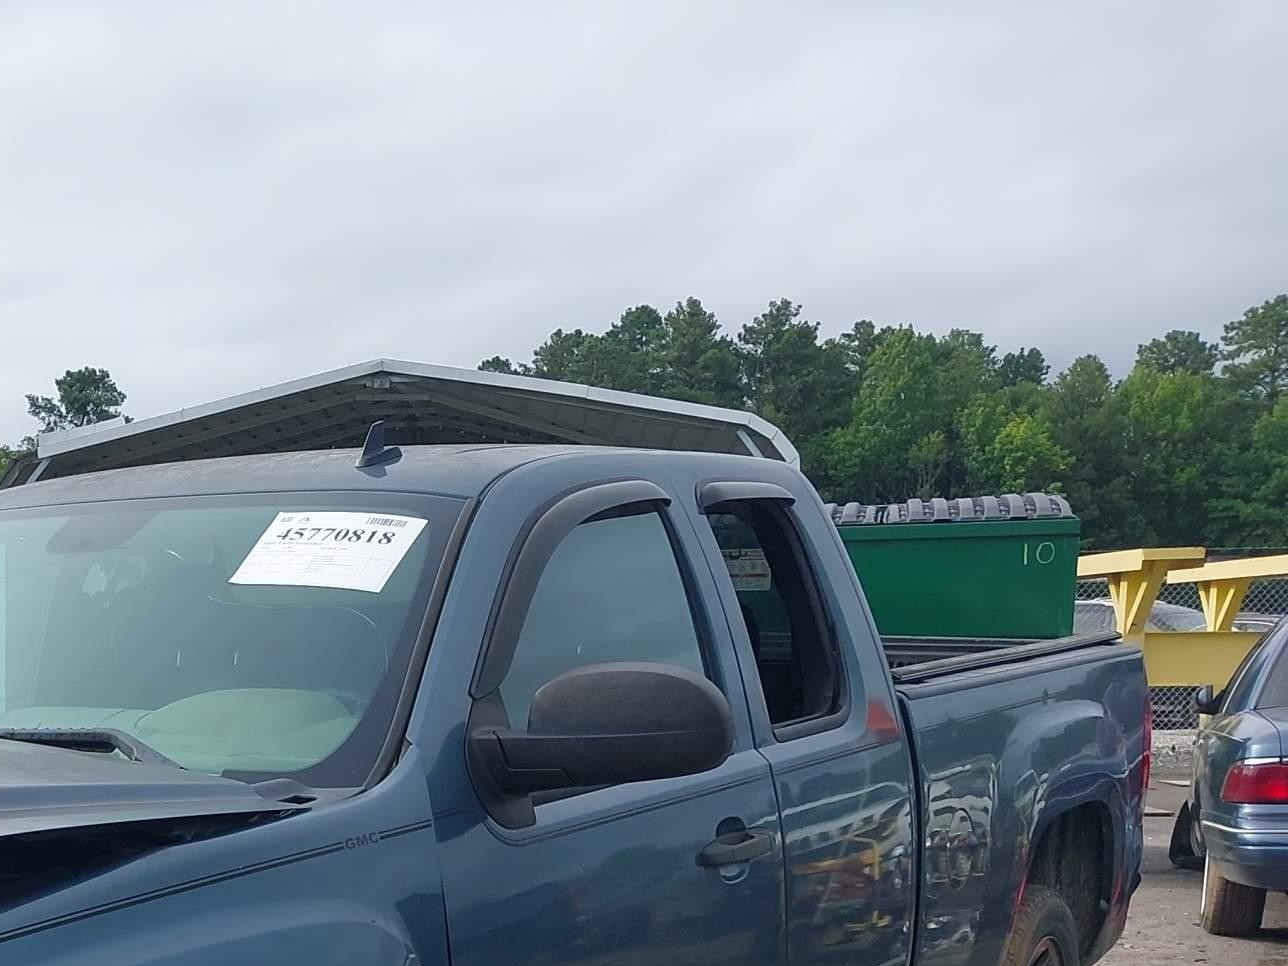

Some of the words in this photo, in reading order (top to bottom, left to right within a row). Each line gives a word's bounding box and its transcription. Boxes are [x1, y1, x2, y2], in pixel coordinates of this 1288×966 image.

[276, 527, 396, 546] 45770818
[1023, 541, 1055, 566] 10
[345, 832, 378, 850] GMC
